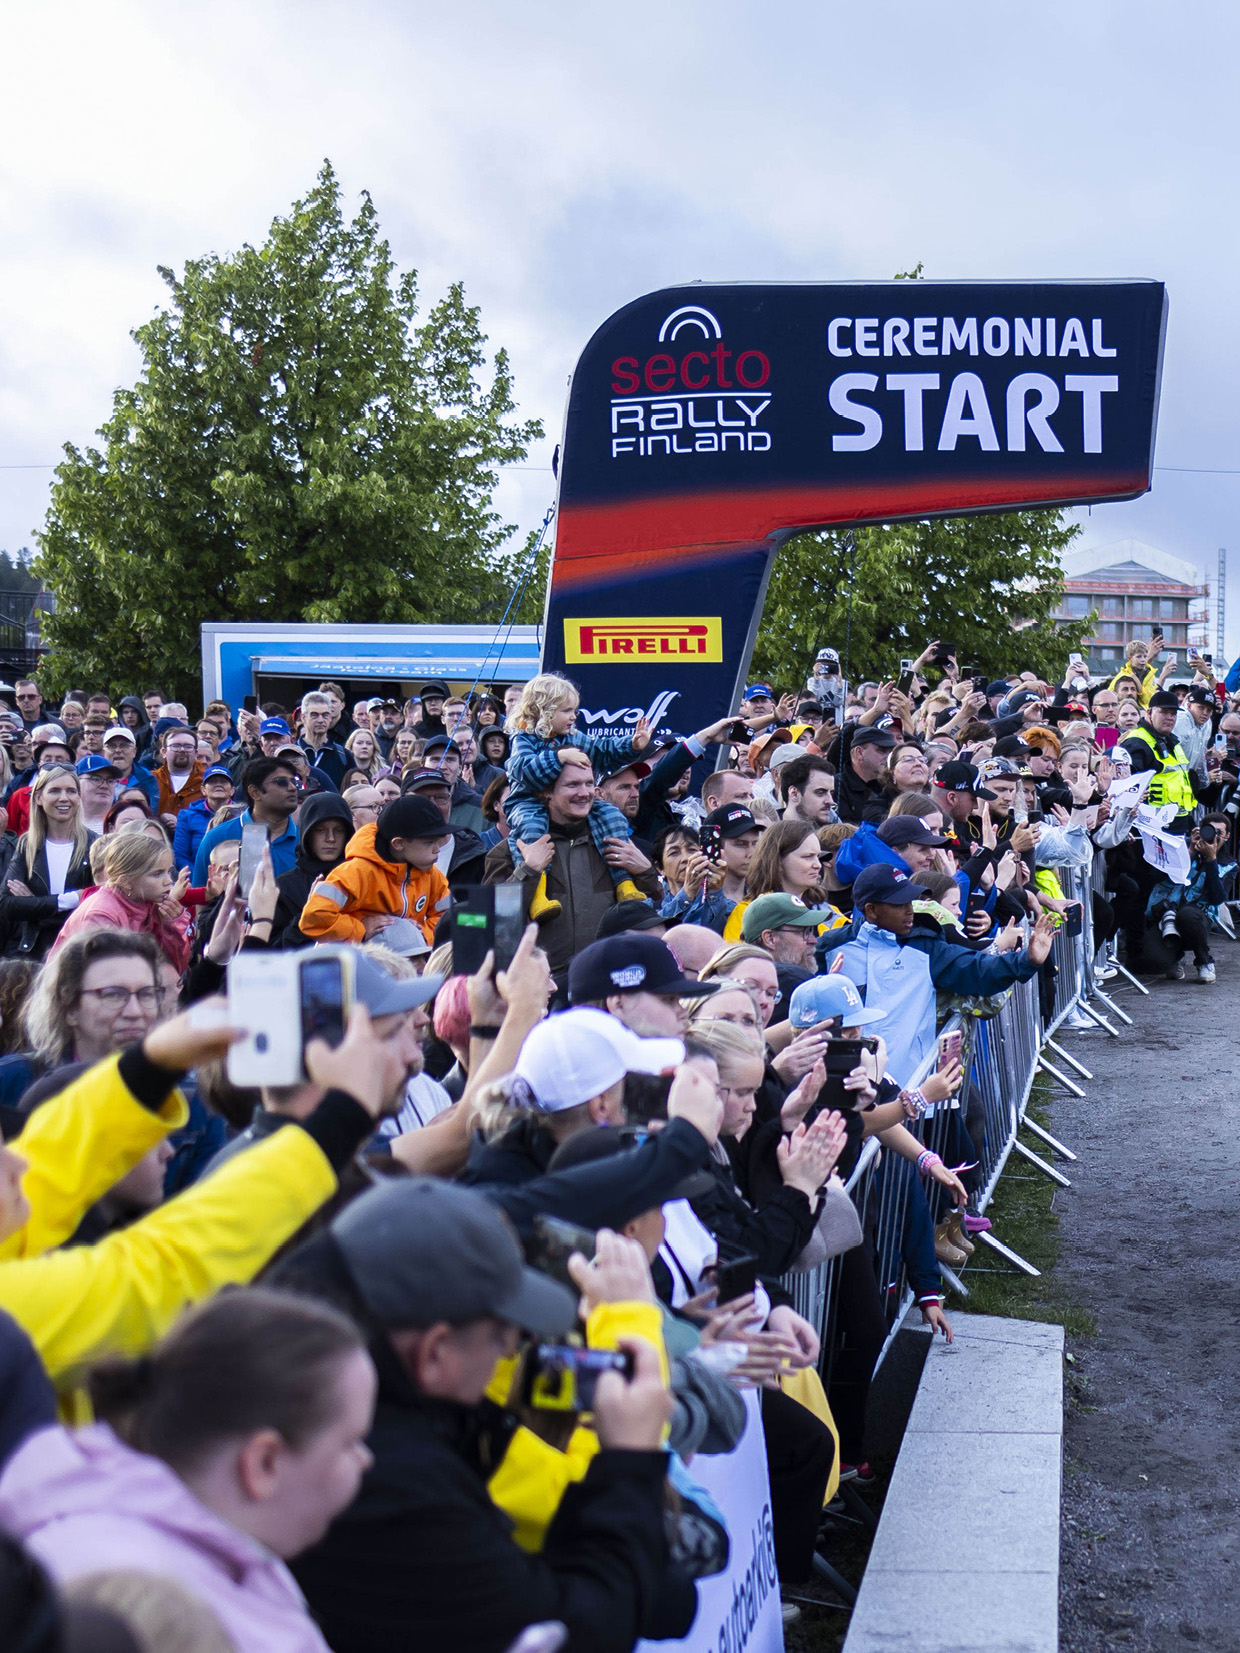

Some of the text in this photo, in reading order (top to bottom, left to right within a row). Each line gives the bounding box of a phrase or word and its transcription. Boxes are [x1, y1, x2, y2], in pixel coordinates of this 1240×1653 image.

[827, 317, 1118, 357] CEREMONIAL
[611, 343, 771, 395] secto
[611, 399, 771, 434] RALLY
[828, 372, 1119, 453] START
[612, 431, 771, 458] FINLAND
[579, 625, 708, 655] PIRELLI
[587, 728, 638, 736] LUBRICANT
